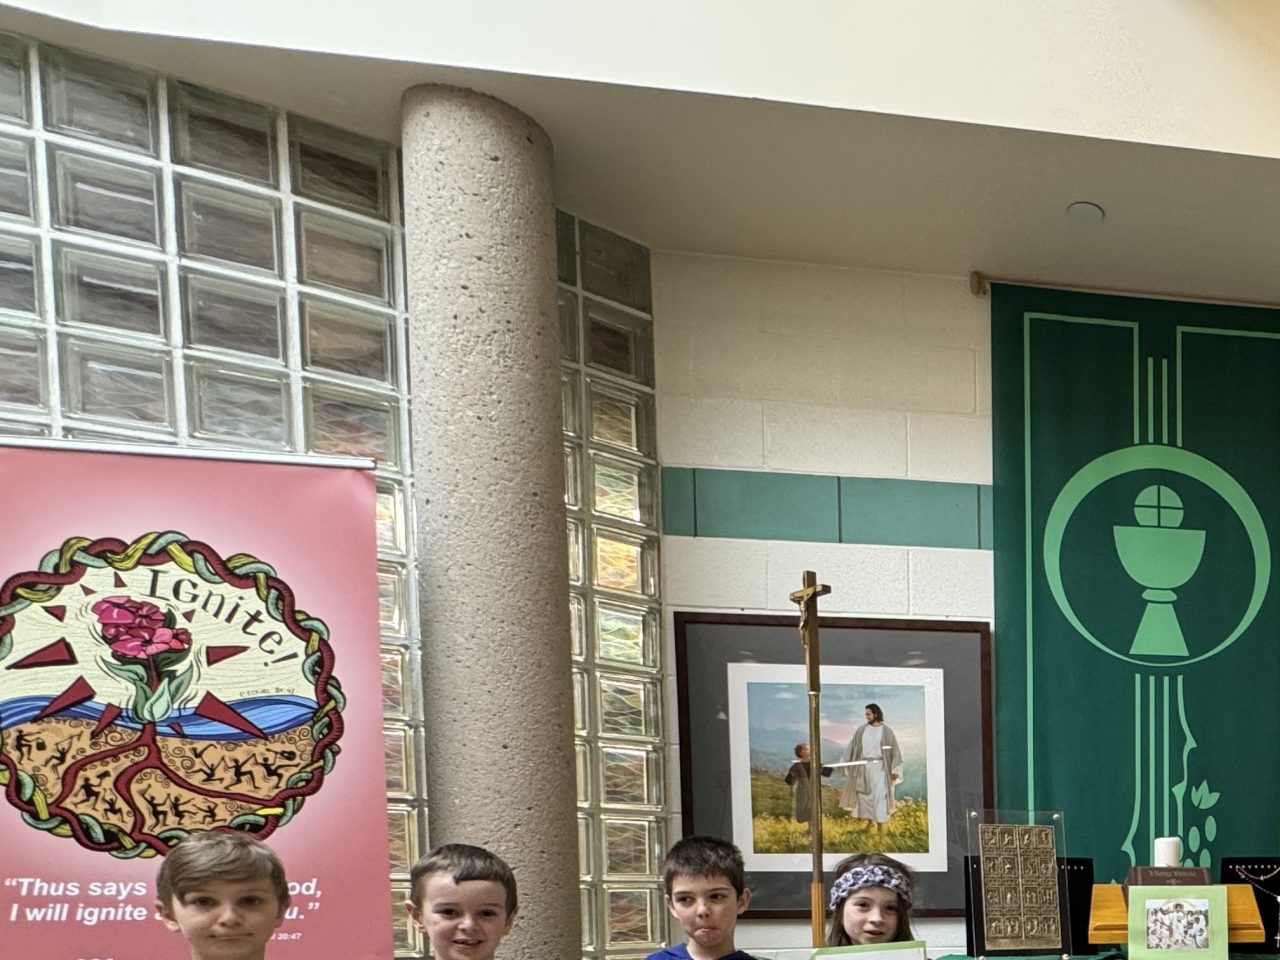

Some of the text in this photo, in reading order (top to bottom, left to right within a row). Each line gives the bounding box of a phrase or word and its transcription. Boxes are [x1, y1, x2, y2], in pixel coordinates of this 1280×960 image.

[88, 881, 147, 900] says
[287, 878, 321, 898] od,
[10, 904, 18, 921] I
[25, 904, 69, 921] will
[75, 904, 147, 926] ignite
